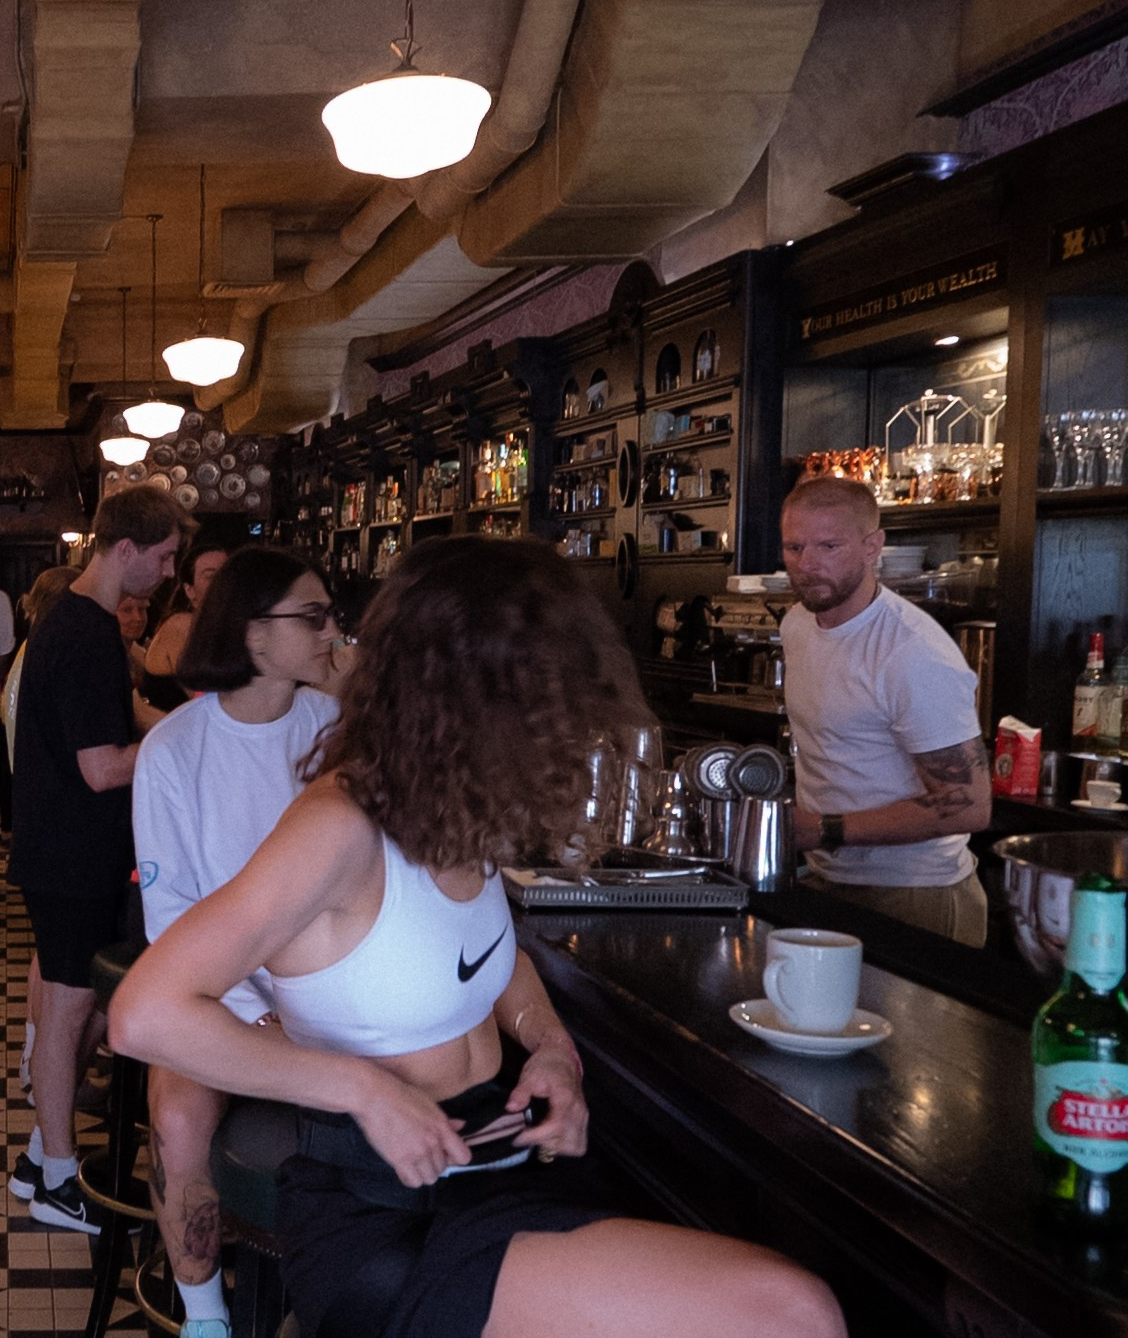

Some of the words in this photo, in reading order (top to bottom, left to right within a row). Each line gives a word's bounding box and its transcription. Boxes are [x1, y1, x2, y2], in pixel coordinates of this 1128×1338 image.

[801, 317, 832, 339] YOUR
[836, 299, 882, 325] HEALTH
[886, 294, 897, 311] IS
[901, 282, 936, 304] YOUR
[938, 262, 998, 293] WEALTH
